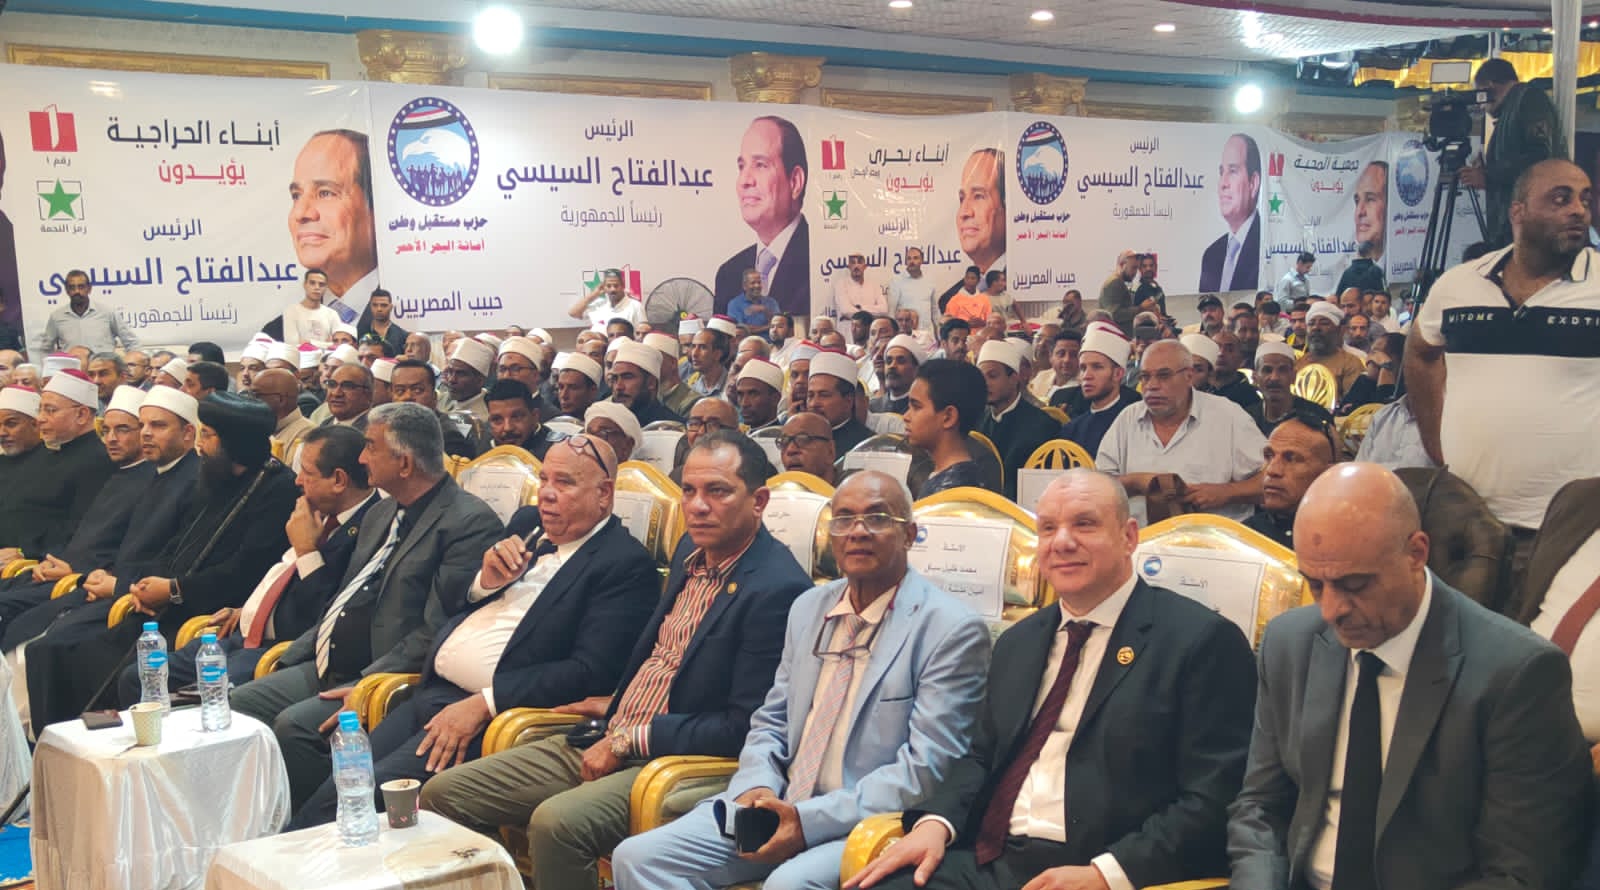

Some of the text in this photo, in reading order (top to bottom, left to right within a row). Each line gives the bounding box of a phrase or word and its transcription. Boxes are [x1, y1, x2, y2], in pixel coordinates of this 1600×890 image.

[106, 115, 281, 150] أبناء الحراجية
[584, 118, 634, 141] الرئيس
[1130, 136, 1160, 154] الرئيس
[53, 156, 71, 167] رقم
[158, 158, 247, 185] يؤيدون
[497, 156, 713, 200] عبدالفتاح السيسي
[1077, 165, 1204, 199] عبدالفتاح السيسي
[388, 213, 488, 231] حزب مستقبل وطن
[561, 205, 625, 227] للجمهورية
[72, 224, 87, 234] رمز
[143, 218, 202, 241] الرئيس
[430, 239, 454, 255] البحر
[38, 255, 298, 305] عبدالفتاح السيي
[393, 290, 503, 319] حبيب المصريين
